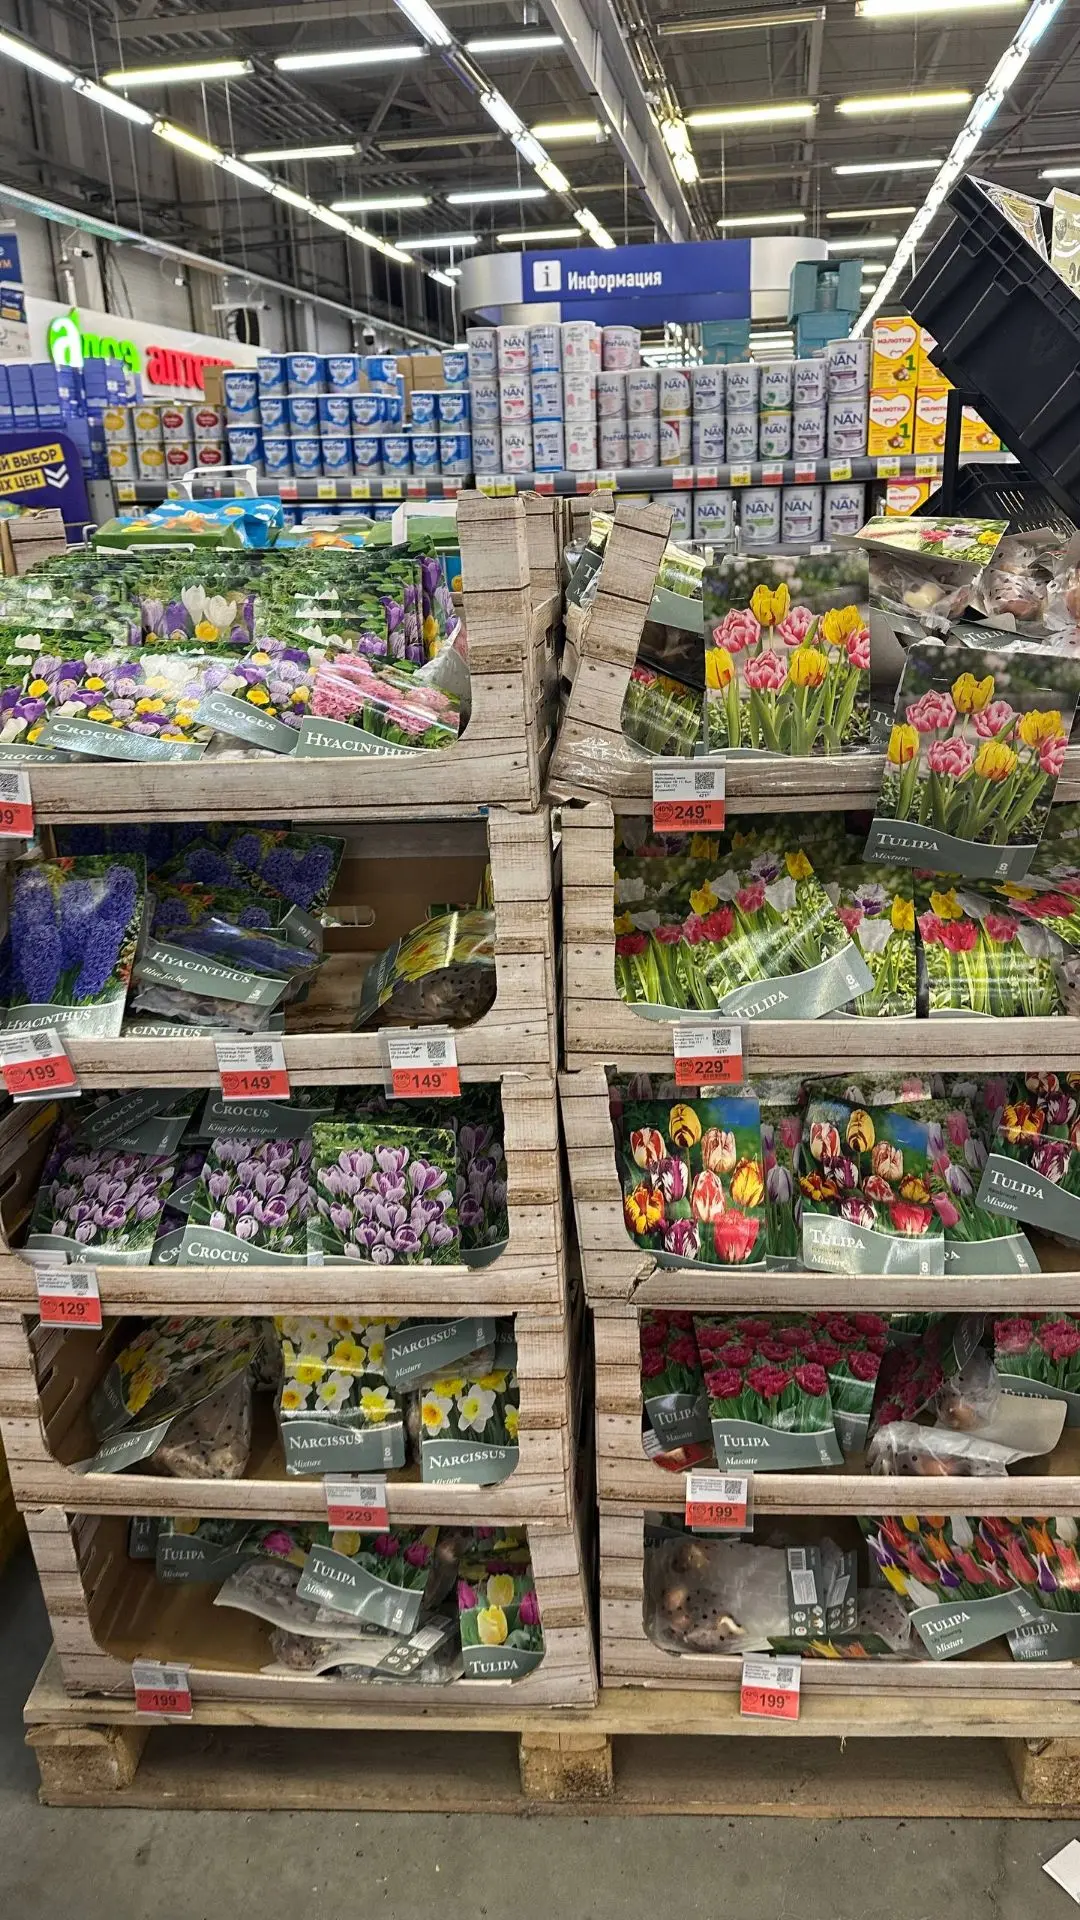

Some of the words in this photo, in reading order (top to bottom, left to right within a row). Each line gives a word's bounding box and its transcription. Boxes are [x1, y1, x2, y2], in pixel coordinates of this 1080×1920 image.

[567, 270, 663, 294] Информация
[905, 354, 916, 371] 1
[899, 422, 911, 439] 1
[12, 448, 57, 469] ВЫБОР
[14, 472, 41, 490] ЦЕН
[210, 700, 277, 731] CROCUS
[52, 722, 129, 742] CROCUS
[674, 805, 705, 820] 249
[876, 833, 940, 851] TULIPA
[871, 851, 911, 862] Mixture
[999, 862, 1009, 871] 8
[150, 951, 251, 984] HYACINTHUS
[845, 974, 856, 985] 8
[731, 990, 790, 1018] TULIPA
[6, 1009, 92, 1030] HYACINTHUS
[26, 1063, 56, 1081] 199
[694, 1060, 724, 1074] 229
[240, 1075, 271, 1090] 149
[411, 1074, 442, 1089] 149
[91, 1095, 144, 1132] CROCUS
[211, 1102, 270, 1118] CROCUS
[207, 1123, 227, 1134] King
[990, 1169, 1044, 1200] TULIPA
[983, 1194, 1019, 1212] Mixture
[809, 1228, 866, 1249] TULIPA
[187, 1241, 250, 1263] CROCUS
[1016, 1254, 1025, 1264] 8
[920, 1261, 929, 1272] 8
[58, 1301, 85, 1316] 129
[390, 1325, 457, 1360] NARCISSUS
[395, 1362, 422, 1378] Mixture
[654, 1407, 700, 1425] TULIPA
[289, 1434, 364, 1449] NARCISSUS
[719, 1434, 770, 1447] TULIPA
[384, 1447, 392, 1456] 8
[429, 1449, 506, 1469] NARCISSUS
[293, 1459, 322, 1469] Mixture
[725, 1456, 758, 1466] Mascotte
[345, 1510, 373, 1522] 229
[708, 1505, 734, 1518] 199
[161, 1547, 206, 1561] TULIPA
[312, 1558, 357, 1587] TULIPA
[921, 1611, 971, 1636] TULIPA
[1014, 1622, 1059, 1640] TULIPA
[935, 1637, 965, 1655] Mixture
[470, 1657, 519, 1674] TULIPA
[152, 1694, 177, 1707] 199
[760, 1693, 785, 1709] 199
